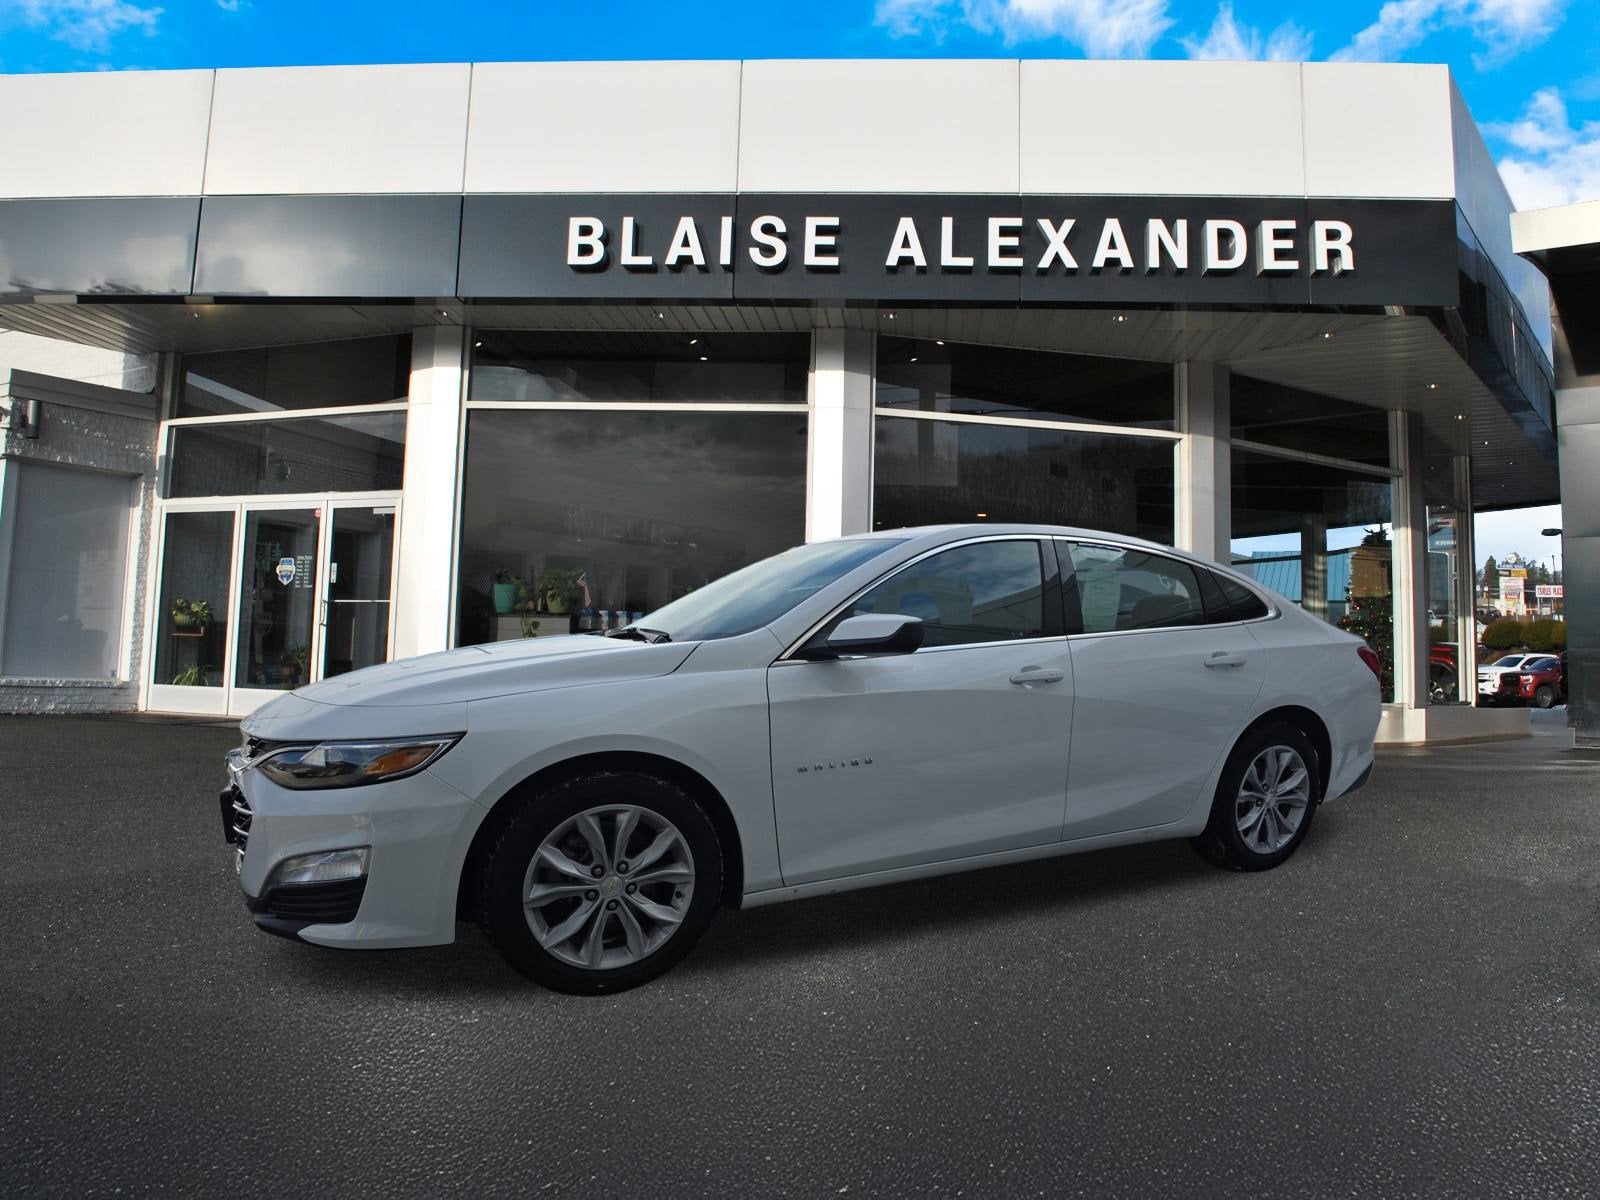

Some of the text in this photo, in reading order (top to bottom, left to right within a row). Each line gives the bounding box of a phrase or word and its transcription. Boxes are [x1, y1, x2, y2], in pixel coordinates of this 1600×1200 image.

[566, 216, 1356, 273] BLAISE ALEXANDER
[796, 755, 874, 774] MALIBU
